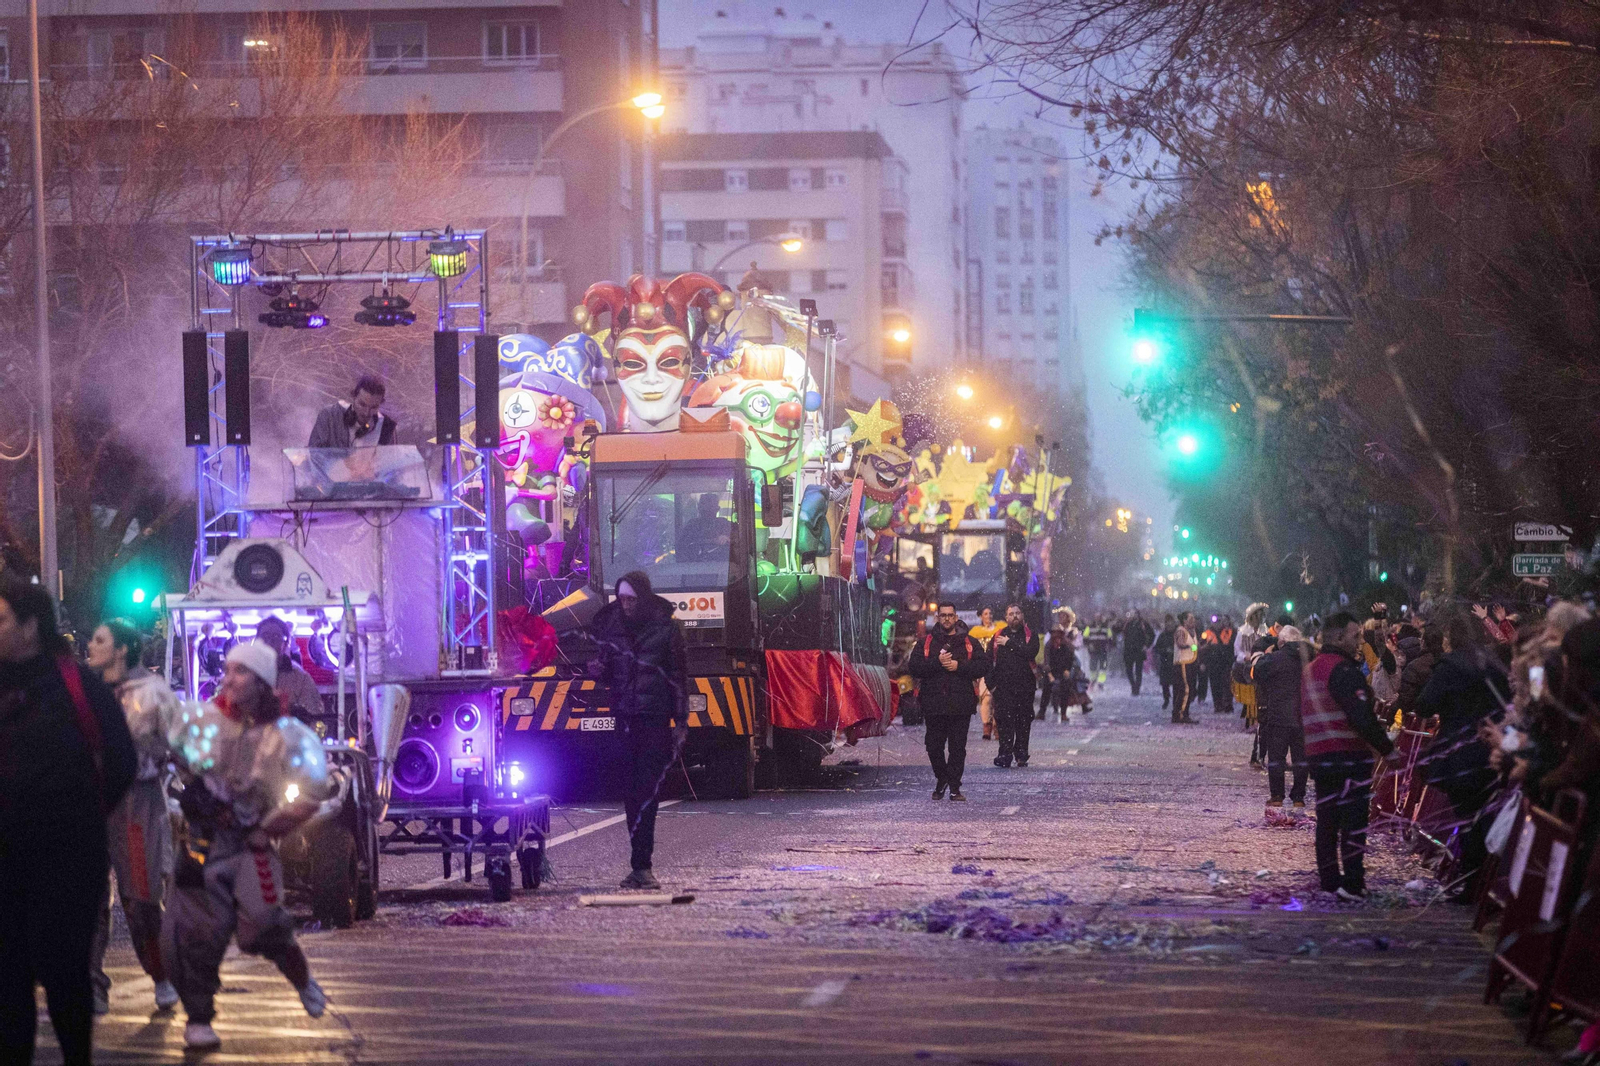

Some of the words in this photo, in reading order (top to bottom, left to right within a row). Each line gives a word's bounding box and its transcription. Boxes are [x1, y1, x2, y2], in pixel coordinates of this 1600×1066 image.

[1516, 527, 1554, 536] Cambio
[1516, 556, 1548, 564] Barriada
[1516, 564, 1528, 573] La
[1533, 564, 1552, 573] Paz
[583, 720, 589, 729] E
[592, 719, 615, 729] 4939
